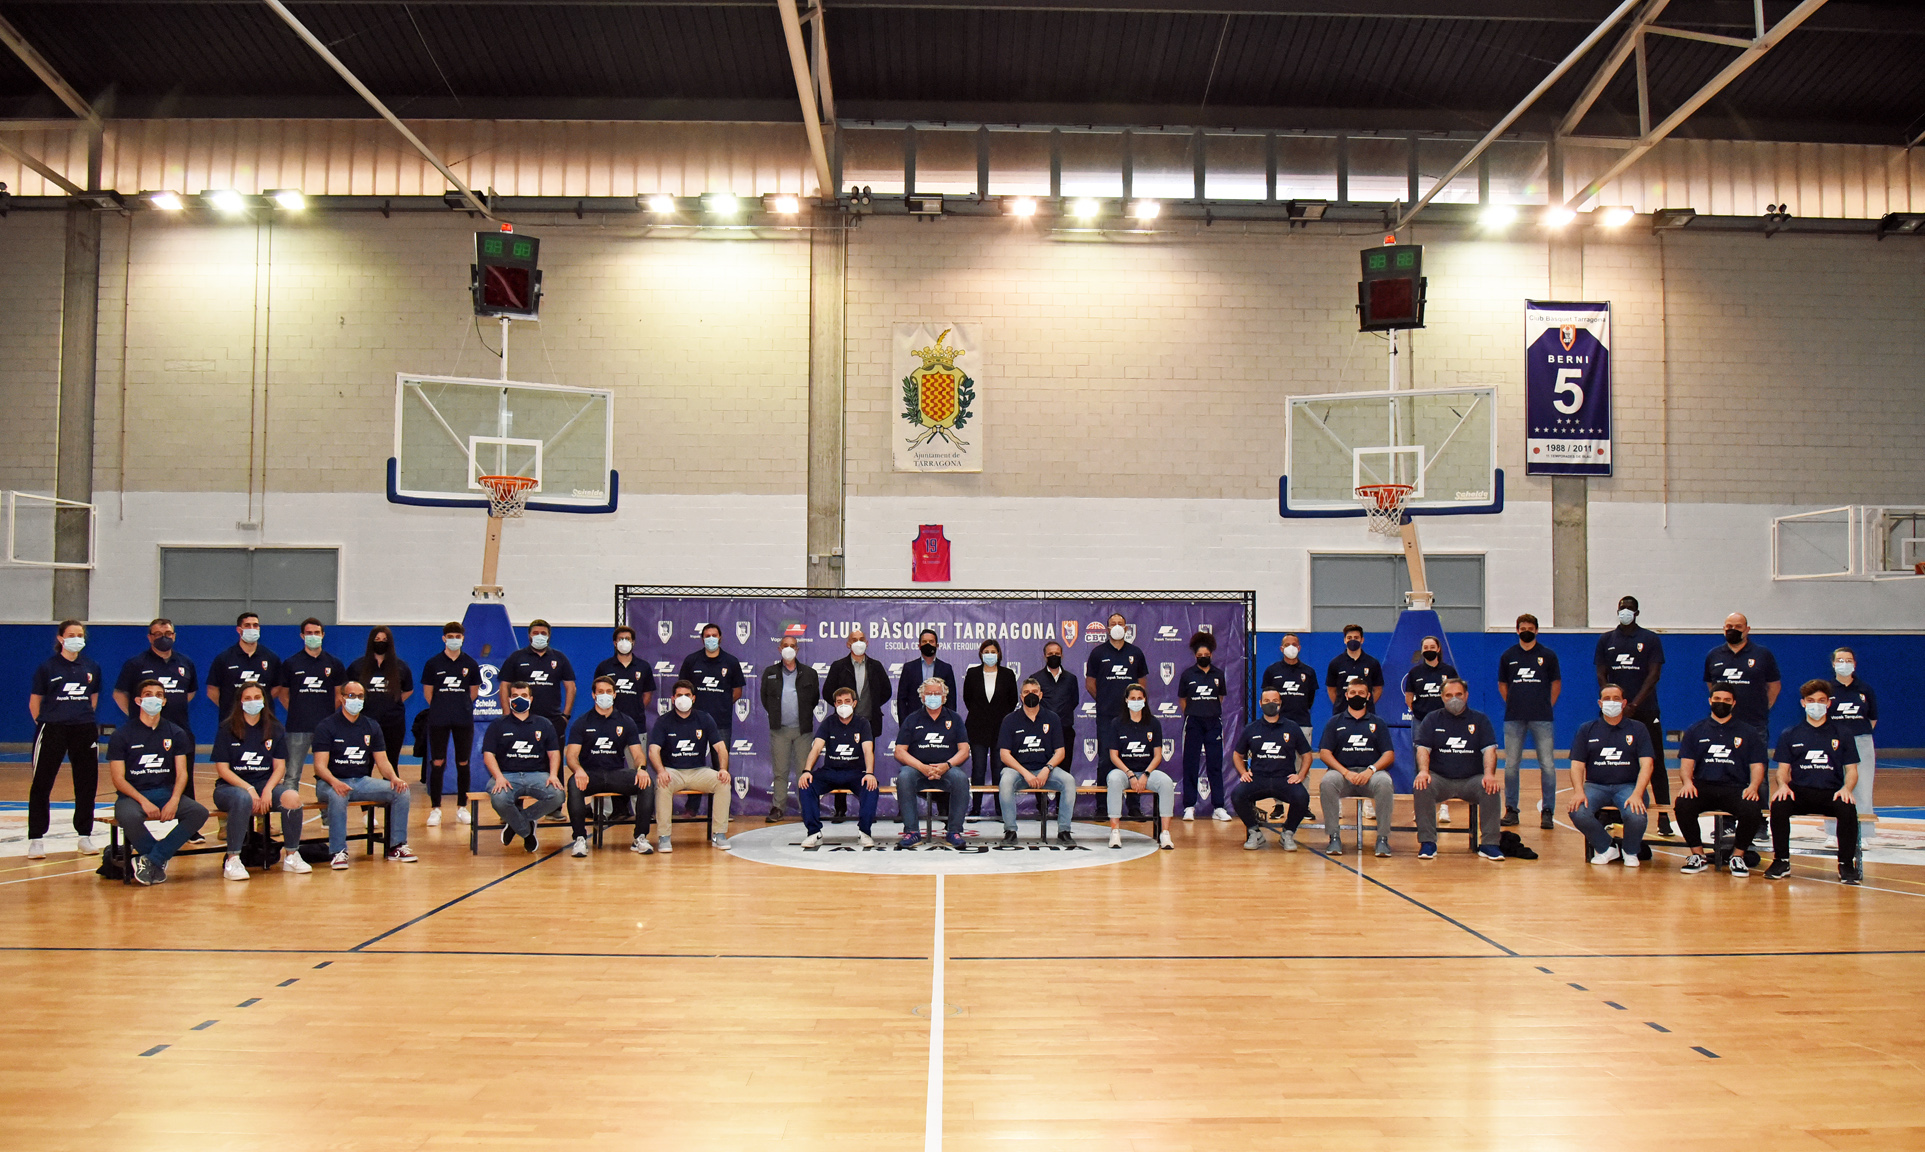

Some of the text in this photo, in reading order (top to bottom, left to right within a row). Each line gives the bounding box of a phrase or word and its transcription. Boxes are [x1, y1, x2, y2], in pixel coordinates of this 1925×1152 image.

[1547, 354, 1589, 364] BERNI
[1552, 368, 1584, 415] 5
[1546, 444, 1566, 452] 1988
[1572, 444, 1592, 453] 2011
[925, 538, 938, 553] 19
[953, 622, 1056, 640] TARRAGONA
[1085, 634, 1107, 642] CBT
[885, 642, 910, 650] ESCOLA
[939, 642, 952, 650] PAK
[952, 642, 982, 651] TERQUIM
[475, 699, 497, 709] Schelde
